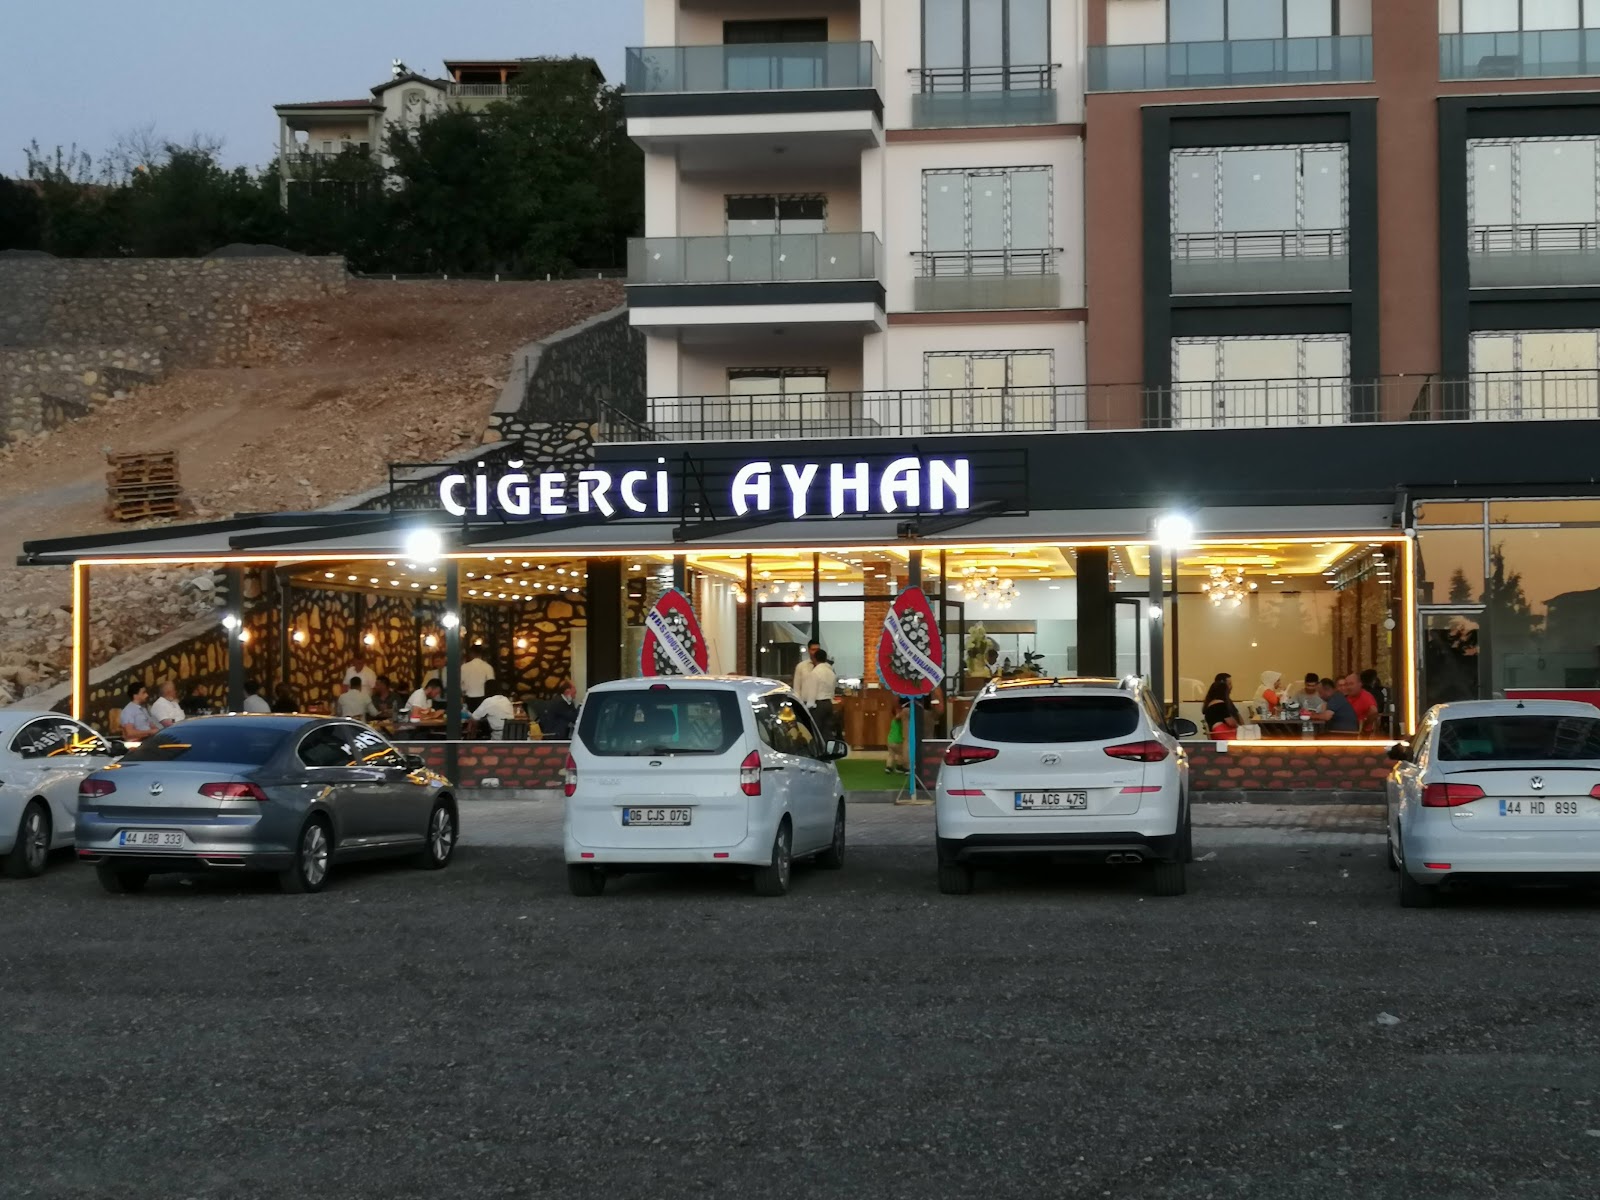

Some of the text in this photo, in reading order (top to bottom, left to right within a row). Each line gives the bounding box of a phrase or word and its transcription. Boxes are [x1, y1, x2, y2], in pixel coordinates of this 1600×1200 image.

[440, 457, 970, 519] CİĞERCİ AYHAN
[1022, 793, 1034, 805] 44
[1066, 793, 1085, 805] 475
[1507, 801, 1577, 814] 44 HD 899
[630, 810, 688, 821] 06 CJS 076
[126, 833, 181, 845] 44 ABB 333
